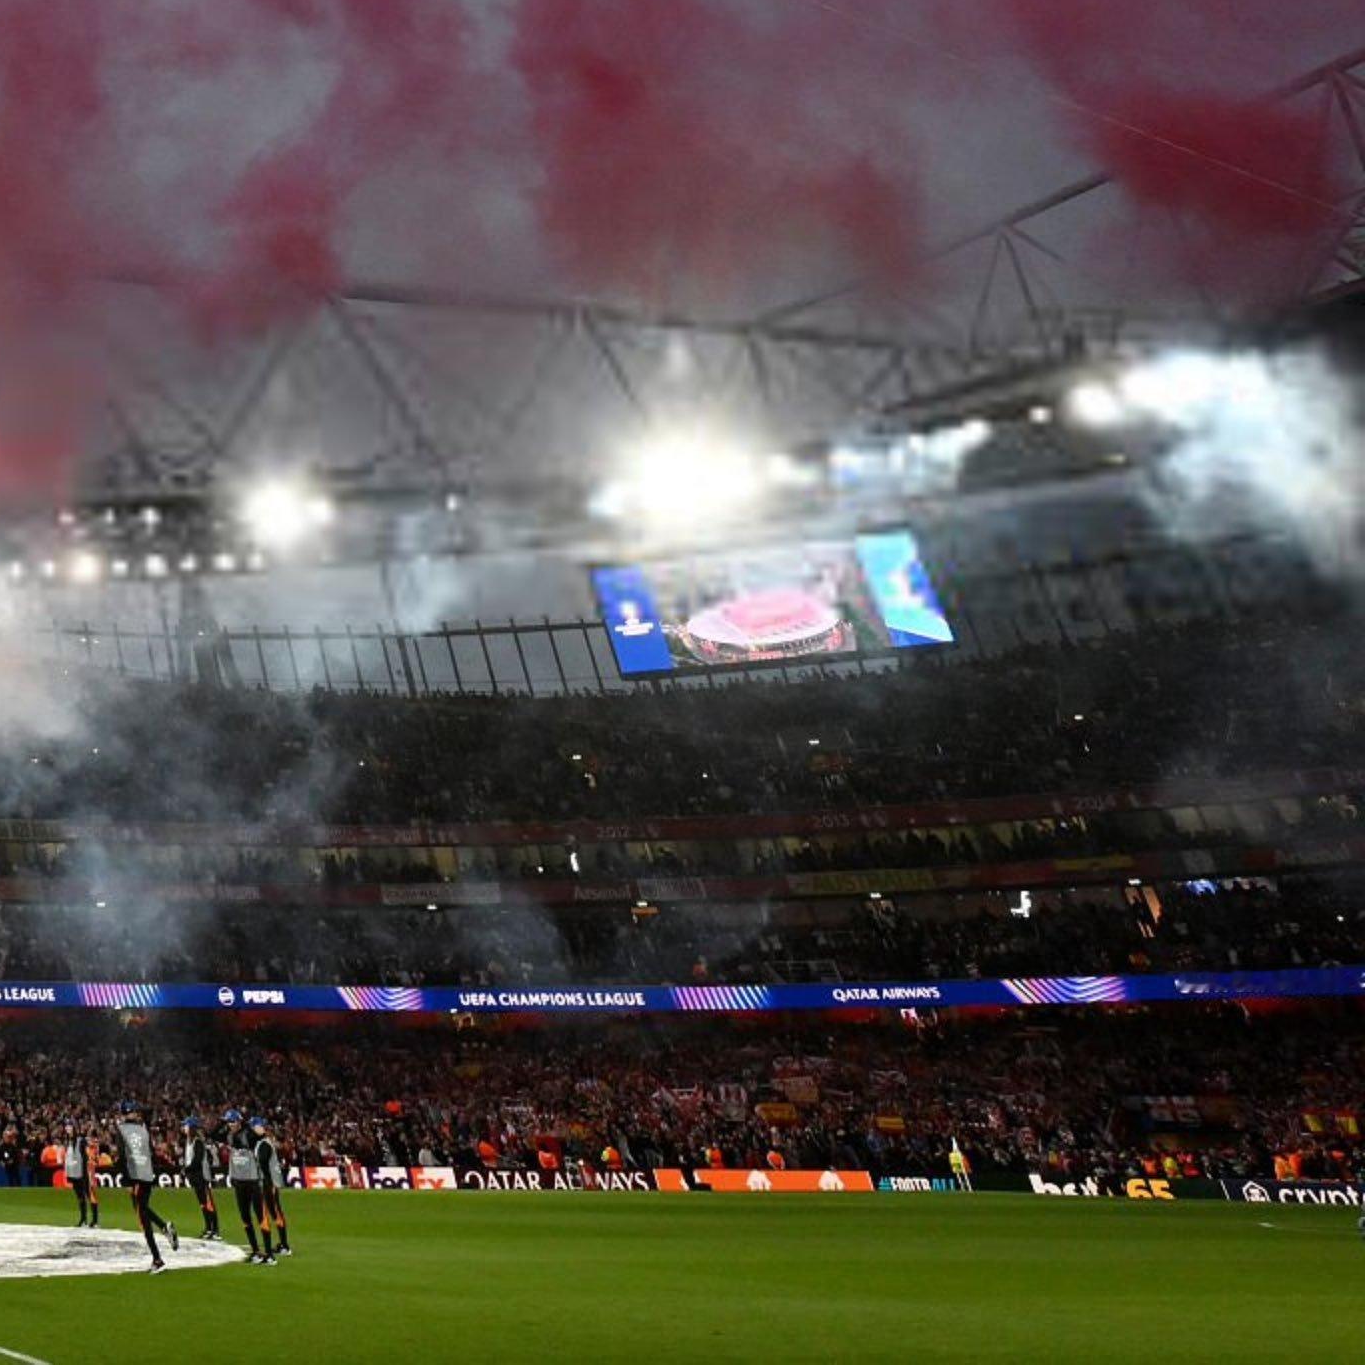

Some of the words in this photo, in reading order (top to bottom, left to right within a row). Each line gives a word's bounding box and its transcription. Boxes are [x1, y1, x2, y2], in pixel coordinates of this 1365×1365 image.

[4, 987, 56, 1001] LEAGUE
[242, 990, 286, 1004] PEPSI
[459, 992, 495, 1006] UEFA
[497, 992, 585, 1006] CHAMPIONS
[586, 993, 646, 1006] LEAGUE
[832, 987, 880, 1002] QATAR
[882, 986, 941, 1001] AIRWAYS
[1028, 1173, 1176, 1200] bet65
[1278, 1185, 1365, 1206] crypt
